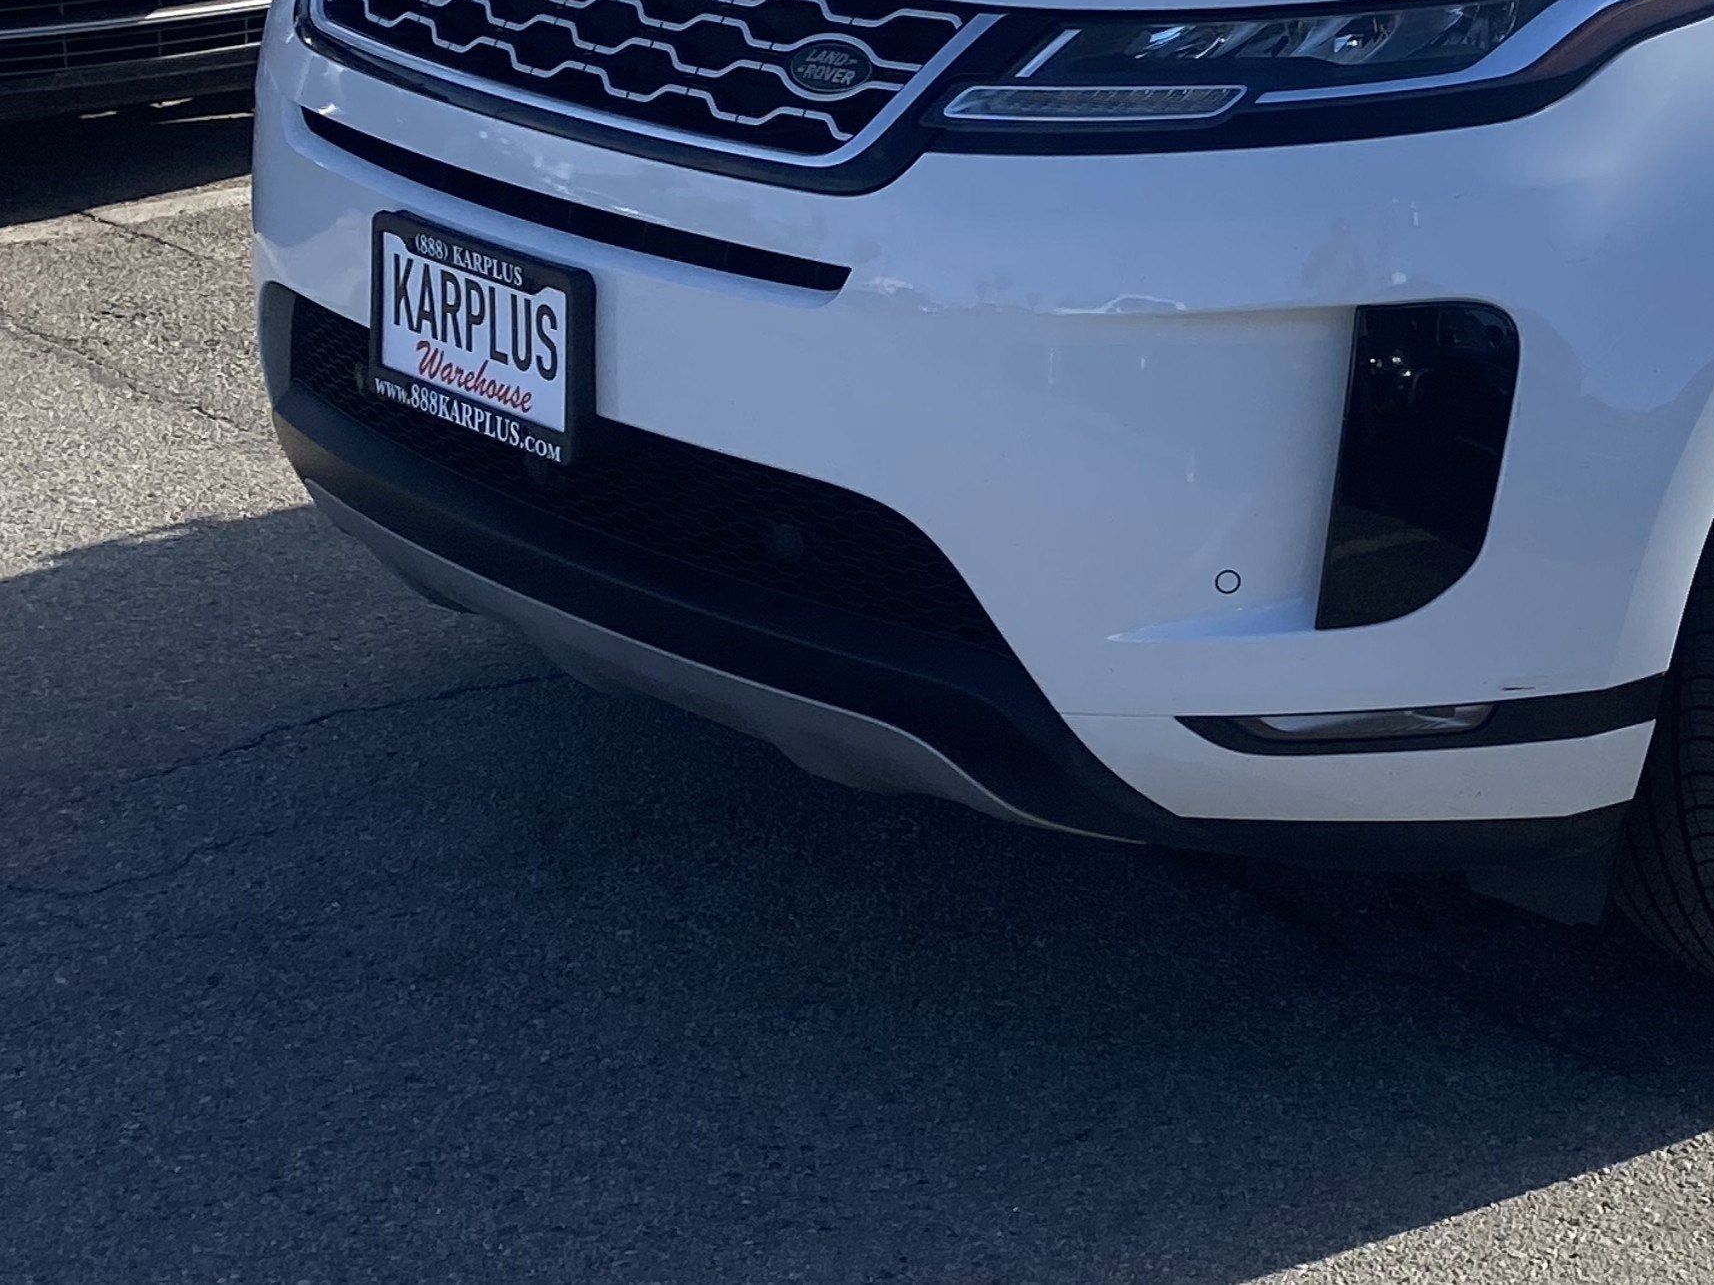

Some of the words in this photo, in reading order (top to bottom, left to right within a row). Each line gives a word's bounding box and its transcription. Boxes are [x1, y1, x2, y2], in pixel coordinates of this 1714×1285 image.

[802, 64, 856, 85] ROVER
[806, 49, 850, 66] LAND
[415, 232, 449, 261] (888)
[453, 245, 524, 287] KARPLUS
[393, 253, 558, 382] KARPLUS
[416, 340, 533, 413] Warehouse
